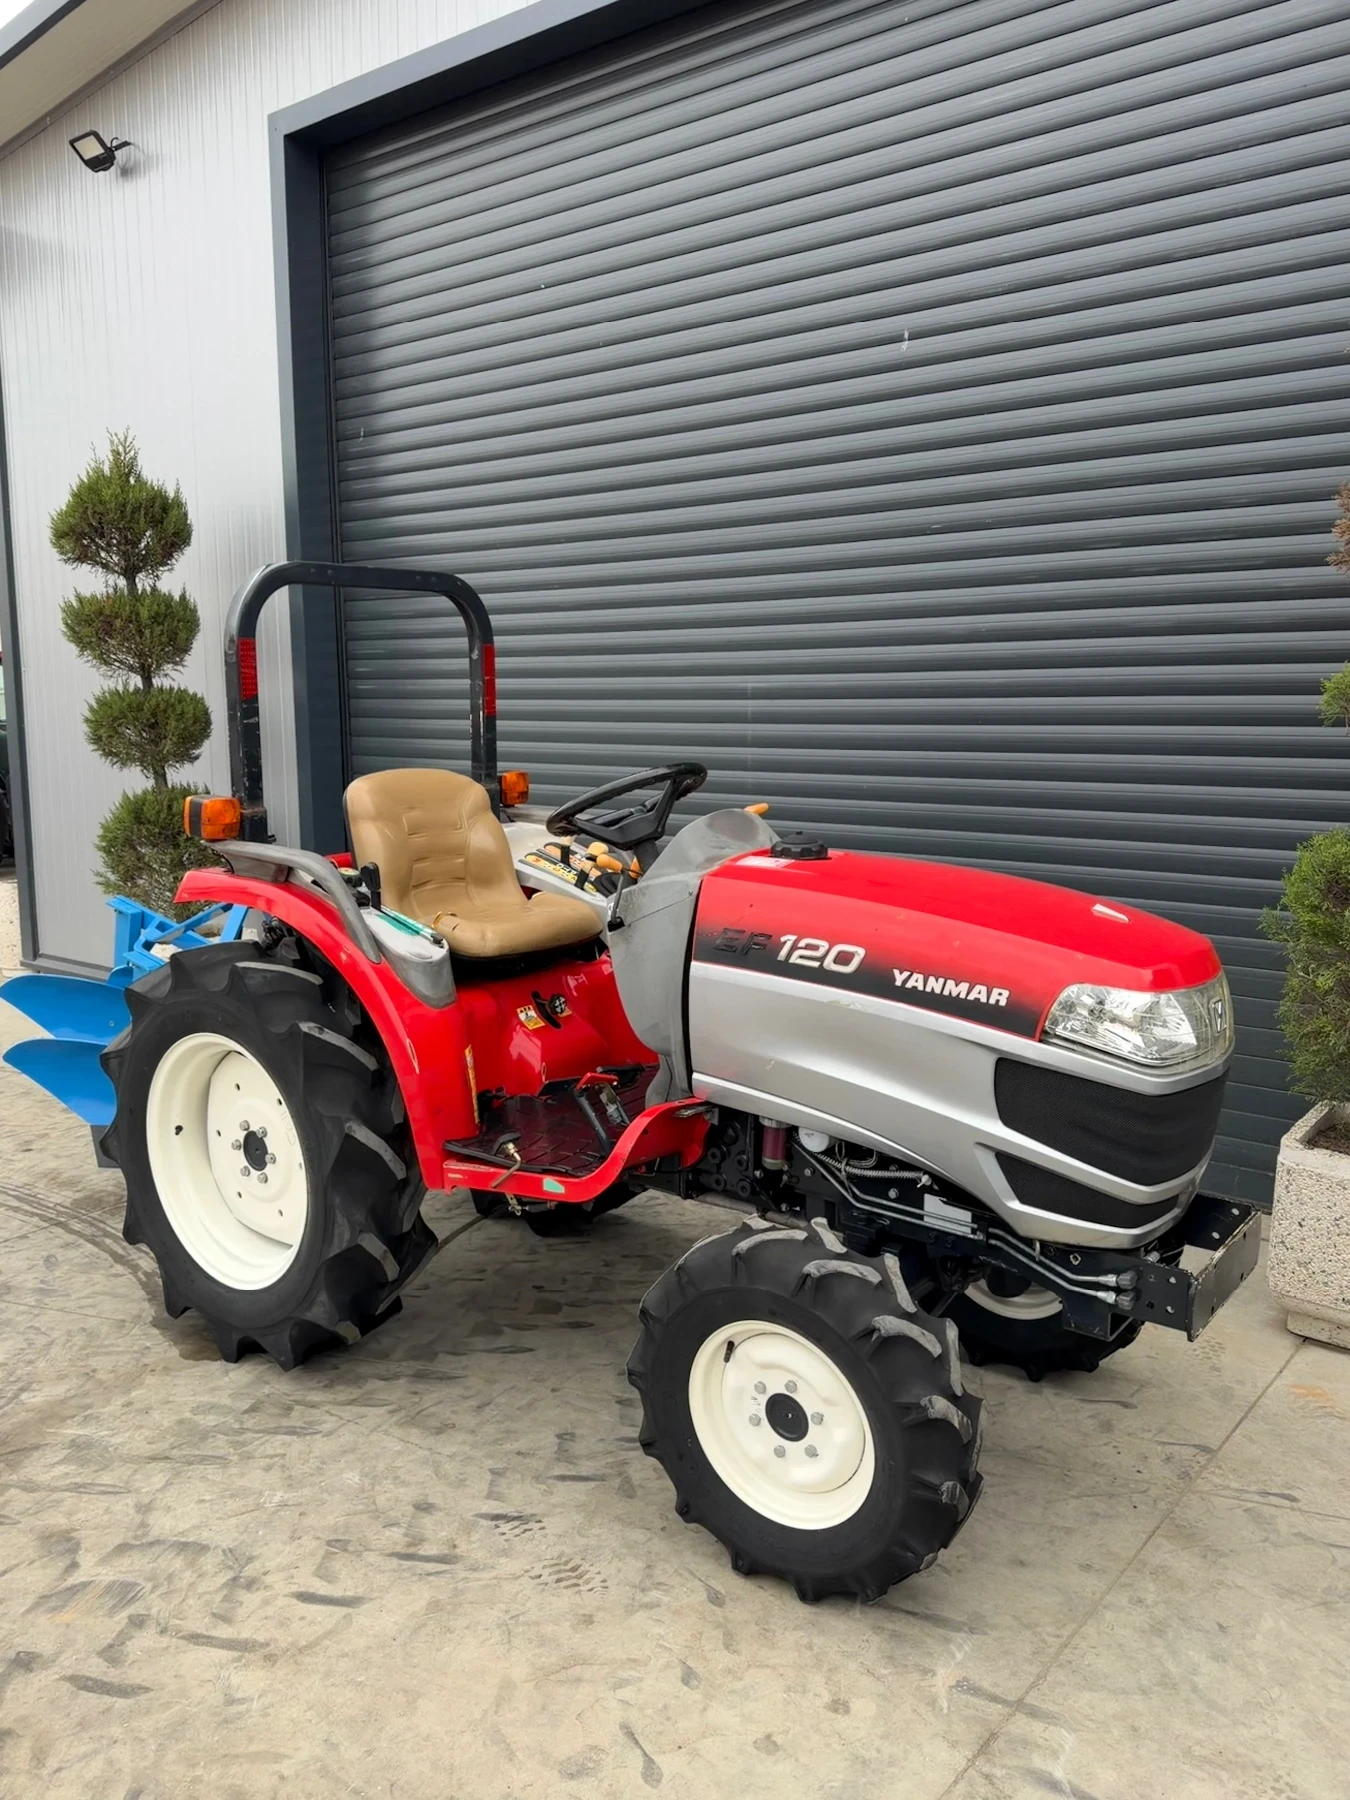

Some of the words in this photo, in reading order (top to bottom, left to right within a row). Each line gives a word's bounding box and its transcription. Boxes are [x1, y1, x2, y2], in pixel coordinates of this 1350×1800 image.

[713, 927, 772, 956] EF
[777, 934, 866, 974] 120
[892, 968, 1010, 1007] YANMAR
